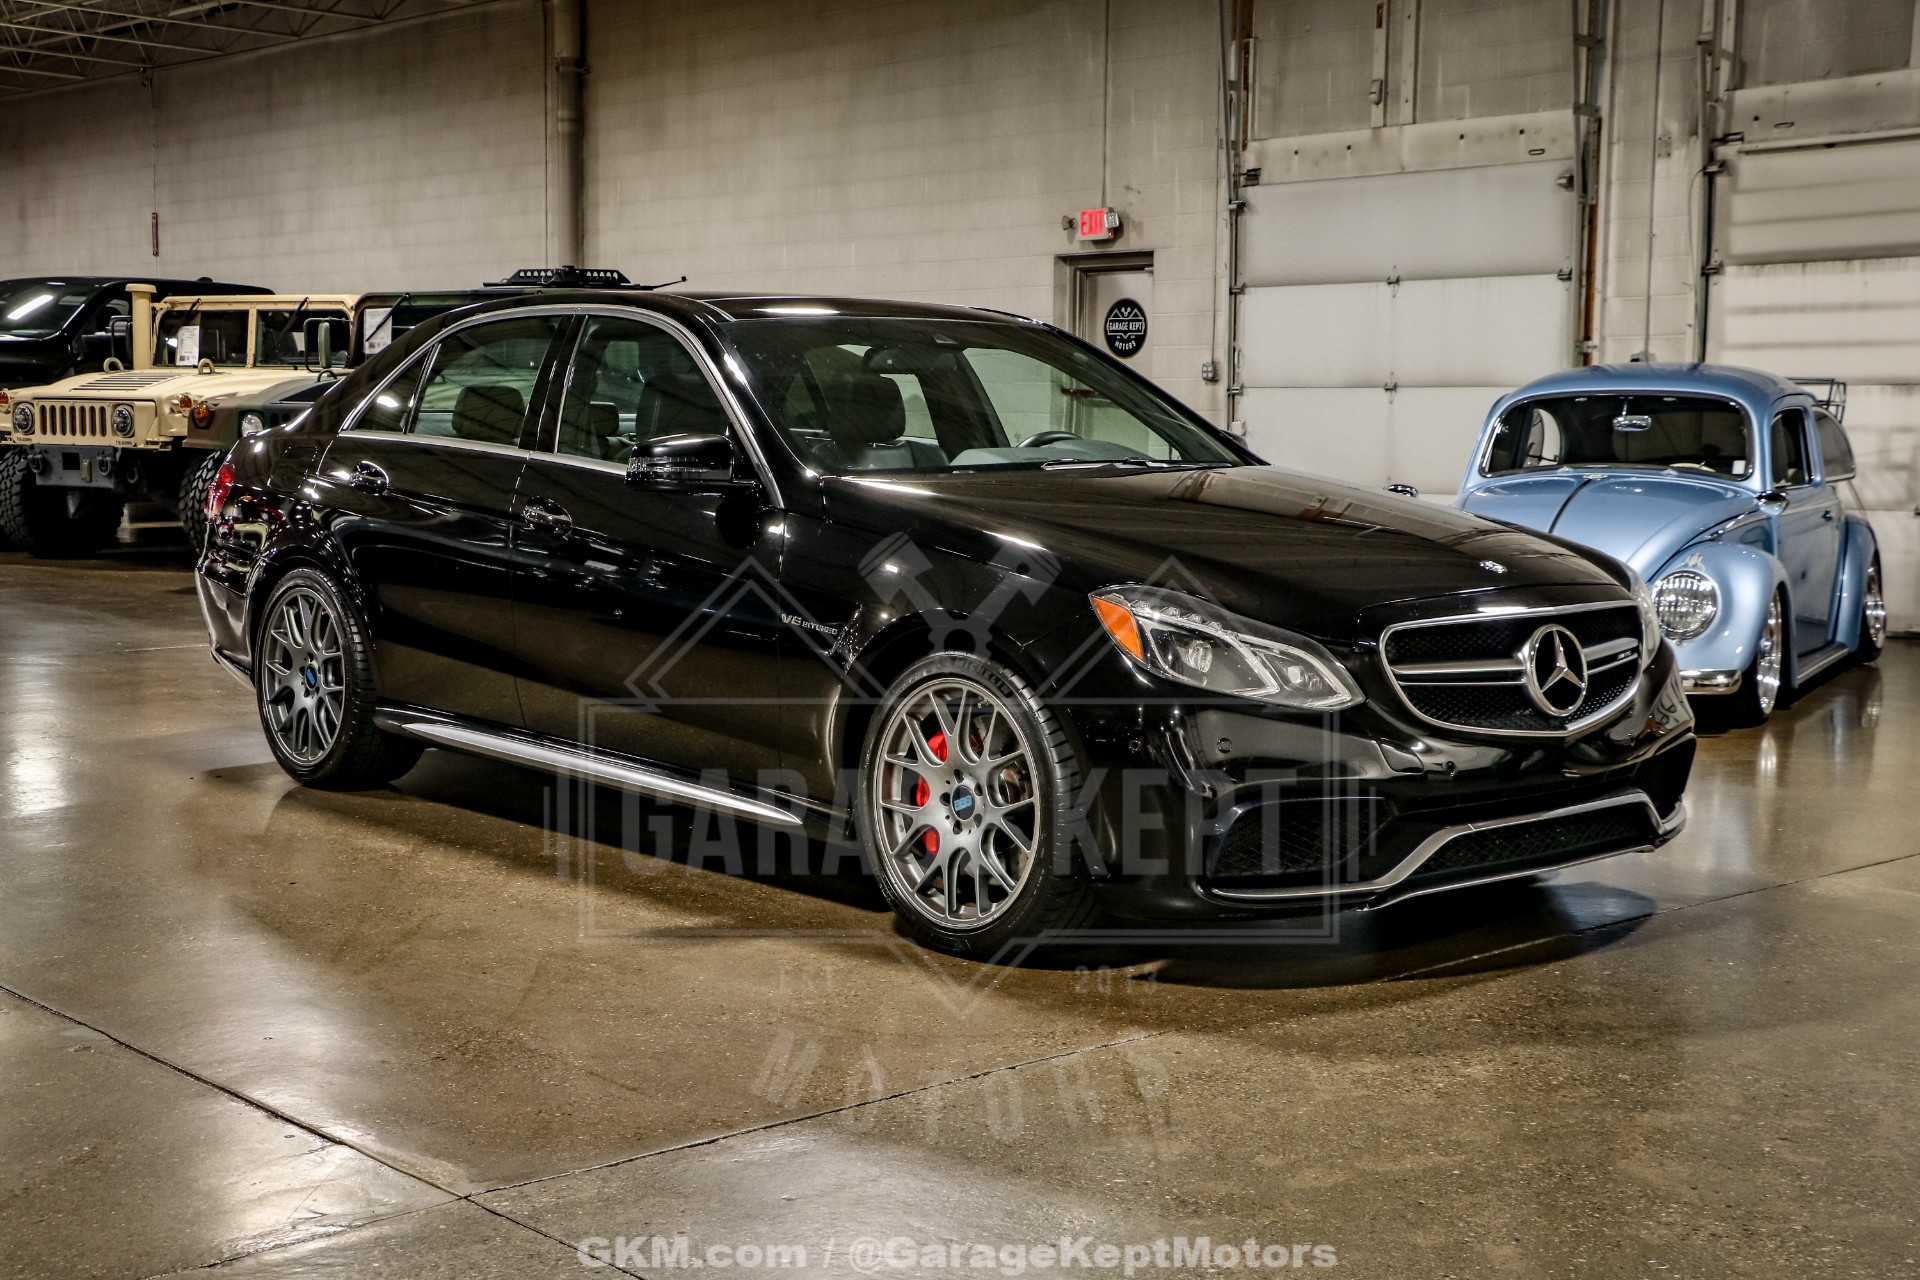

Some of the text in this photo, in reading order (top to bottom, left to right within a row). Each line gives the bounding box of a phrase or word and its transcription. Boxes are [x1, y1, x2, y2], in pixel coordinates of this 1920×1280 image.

[1080, 208, 1105, 236] EXIT
[1109, 321, 1143, 331] GARAGE KEPT
[1114, 340, 1137, 351] MOTORS
